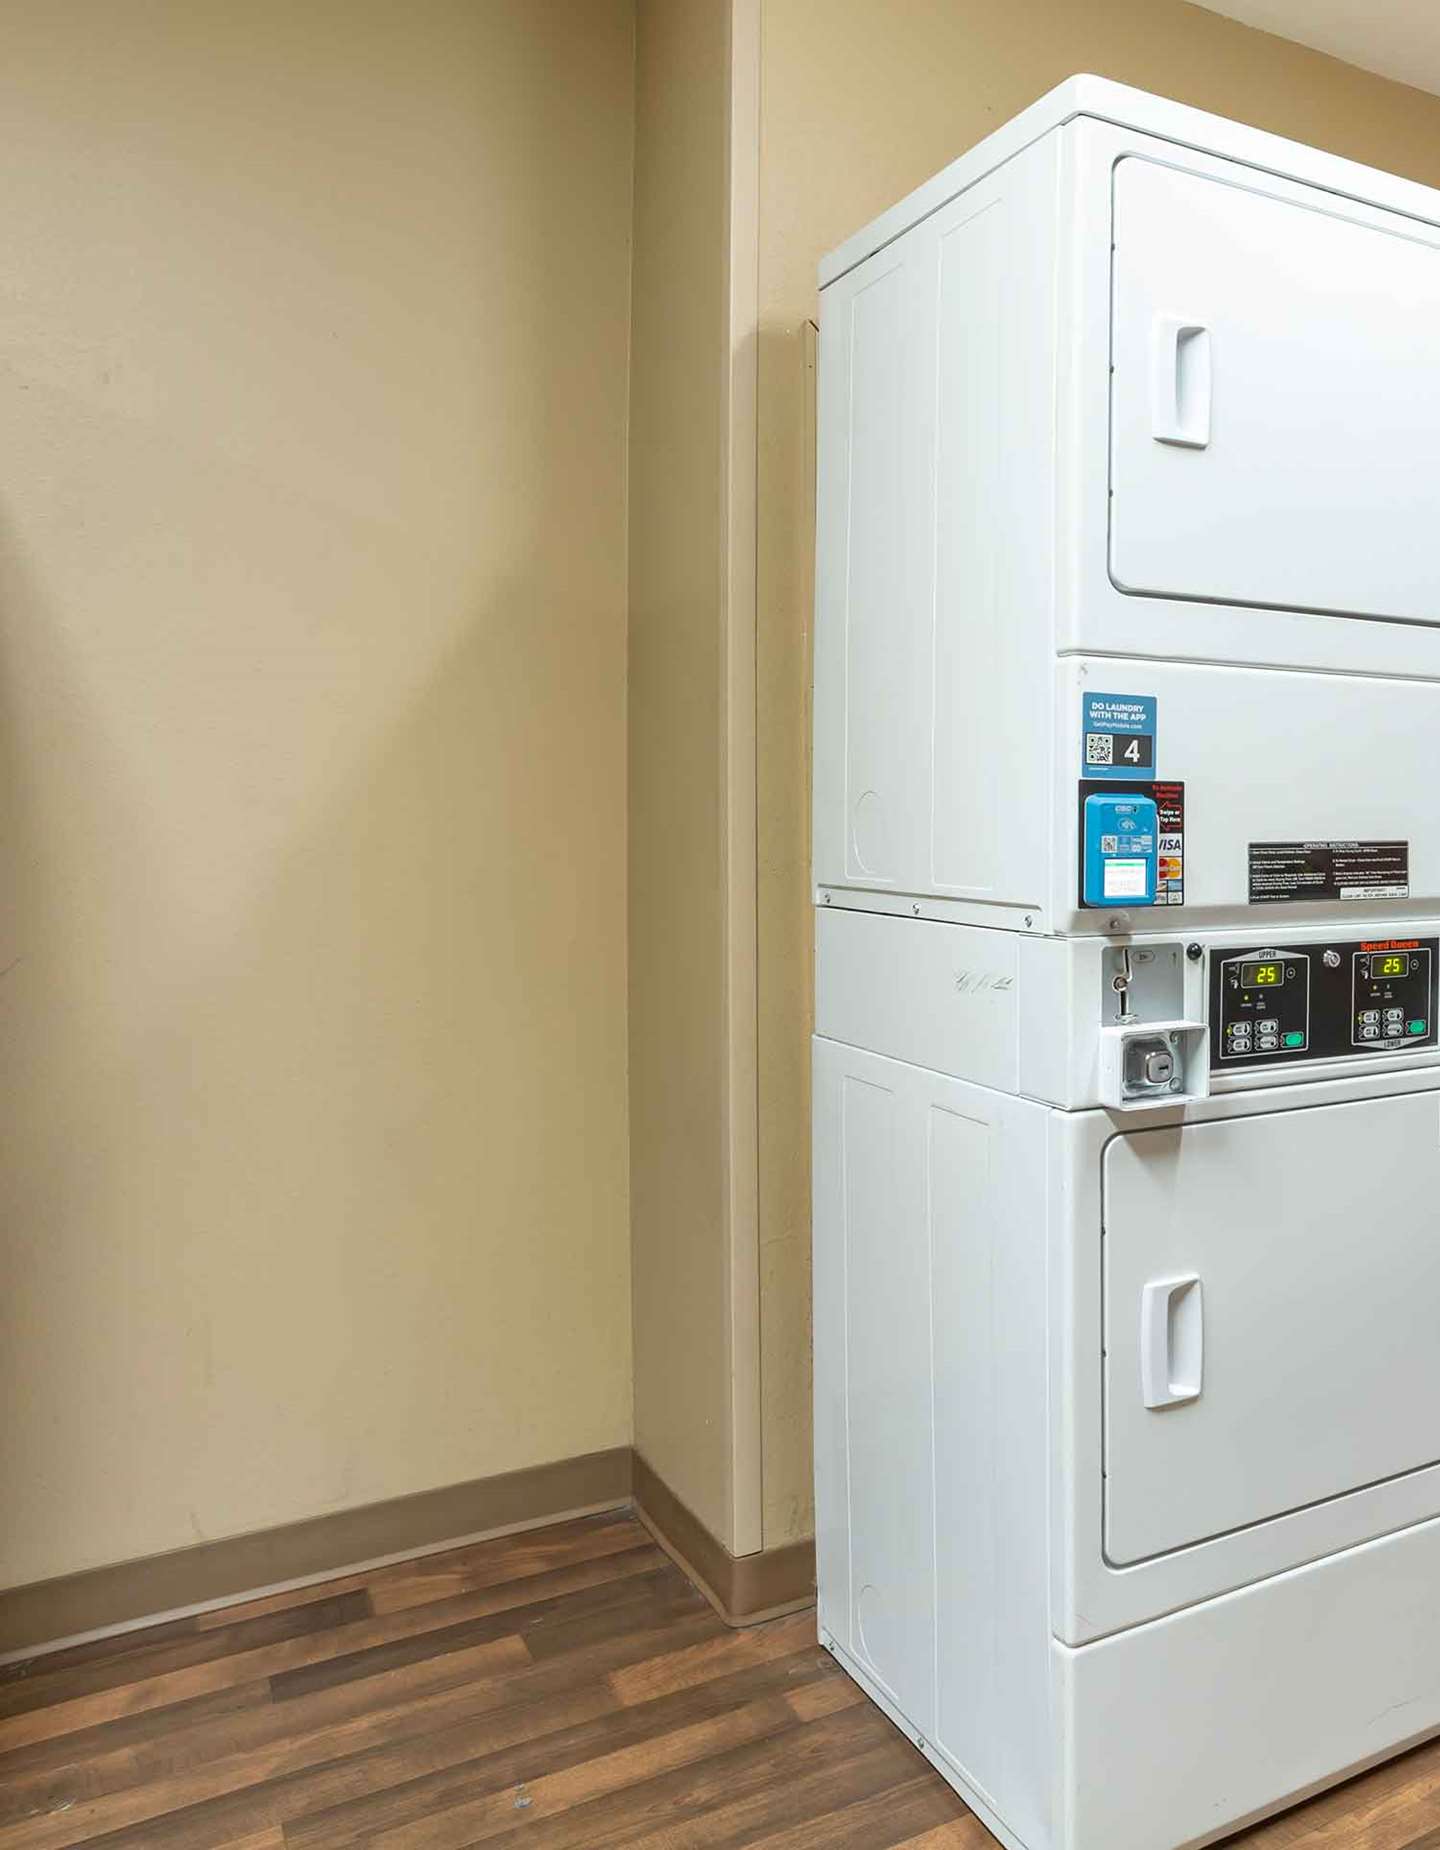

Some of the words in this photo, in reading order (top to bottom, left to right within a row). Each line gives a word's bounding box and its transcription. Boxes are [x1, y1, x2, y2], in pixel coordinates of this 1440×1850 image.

[1091, 702, 1104, 710] DO
[1105, 703, 1144, 712] LAUNDRY
[1089, 711, 1112, 719] WITH
[1113, 711, 1129, 720] THE
[1130, 713, 1147, 721] APP
[1124, 739, 1140, 763] 4
[1360, 941, 1390, 953] Speed
[1390, 940, 1419, 949] Queen
[1258, 951, 1276, 959] UPPER
[1384, 958, 1400, 973] 25
[1257, 967, 1276, 983] 25
[1384, 1040, 1401, 1048] LOWER
